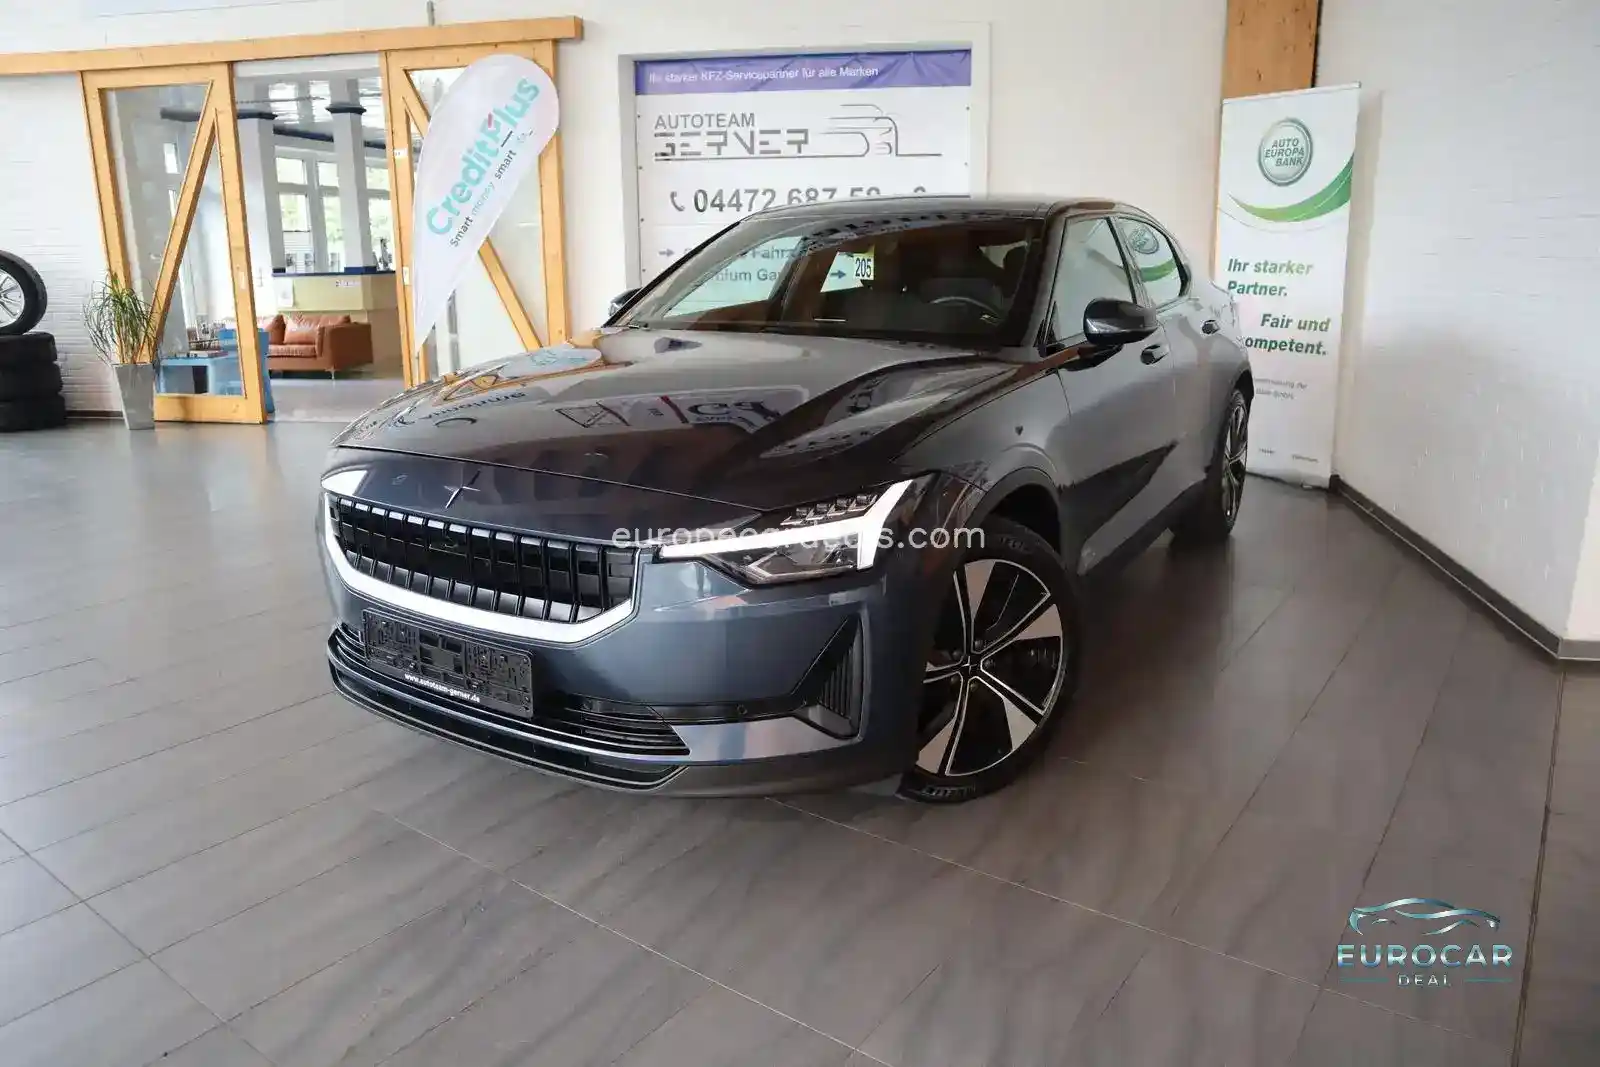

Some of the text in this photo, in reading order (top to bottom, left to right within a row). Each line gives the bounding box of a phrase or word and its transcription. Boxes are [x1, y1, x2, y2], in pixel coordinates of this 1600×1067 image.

[839, 66, 879, 78] Marken
[654, 112, 756, 129] AUTOTEAM
[1272, 138, 1299, 148] AUTO
[426, 78, 540, 235] CreditPlus
[1265, 147, 1305, 158] EUROPA
[1276, 157, 1303, 167] BANK
[450, 215, 473, 247] Smart
[494, 149, 517, 180] smart
[694, 189, 776, 212] 04472
[855, 258, 872, 277] 205
[1228, 258, 1313, 275] Ihr starker
[1227, 280, 1288, 297] Partner.
[1260, 313, 1331, 332] Fair und
[1244, 335, 1327, 356] ompetent.
